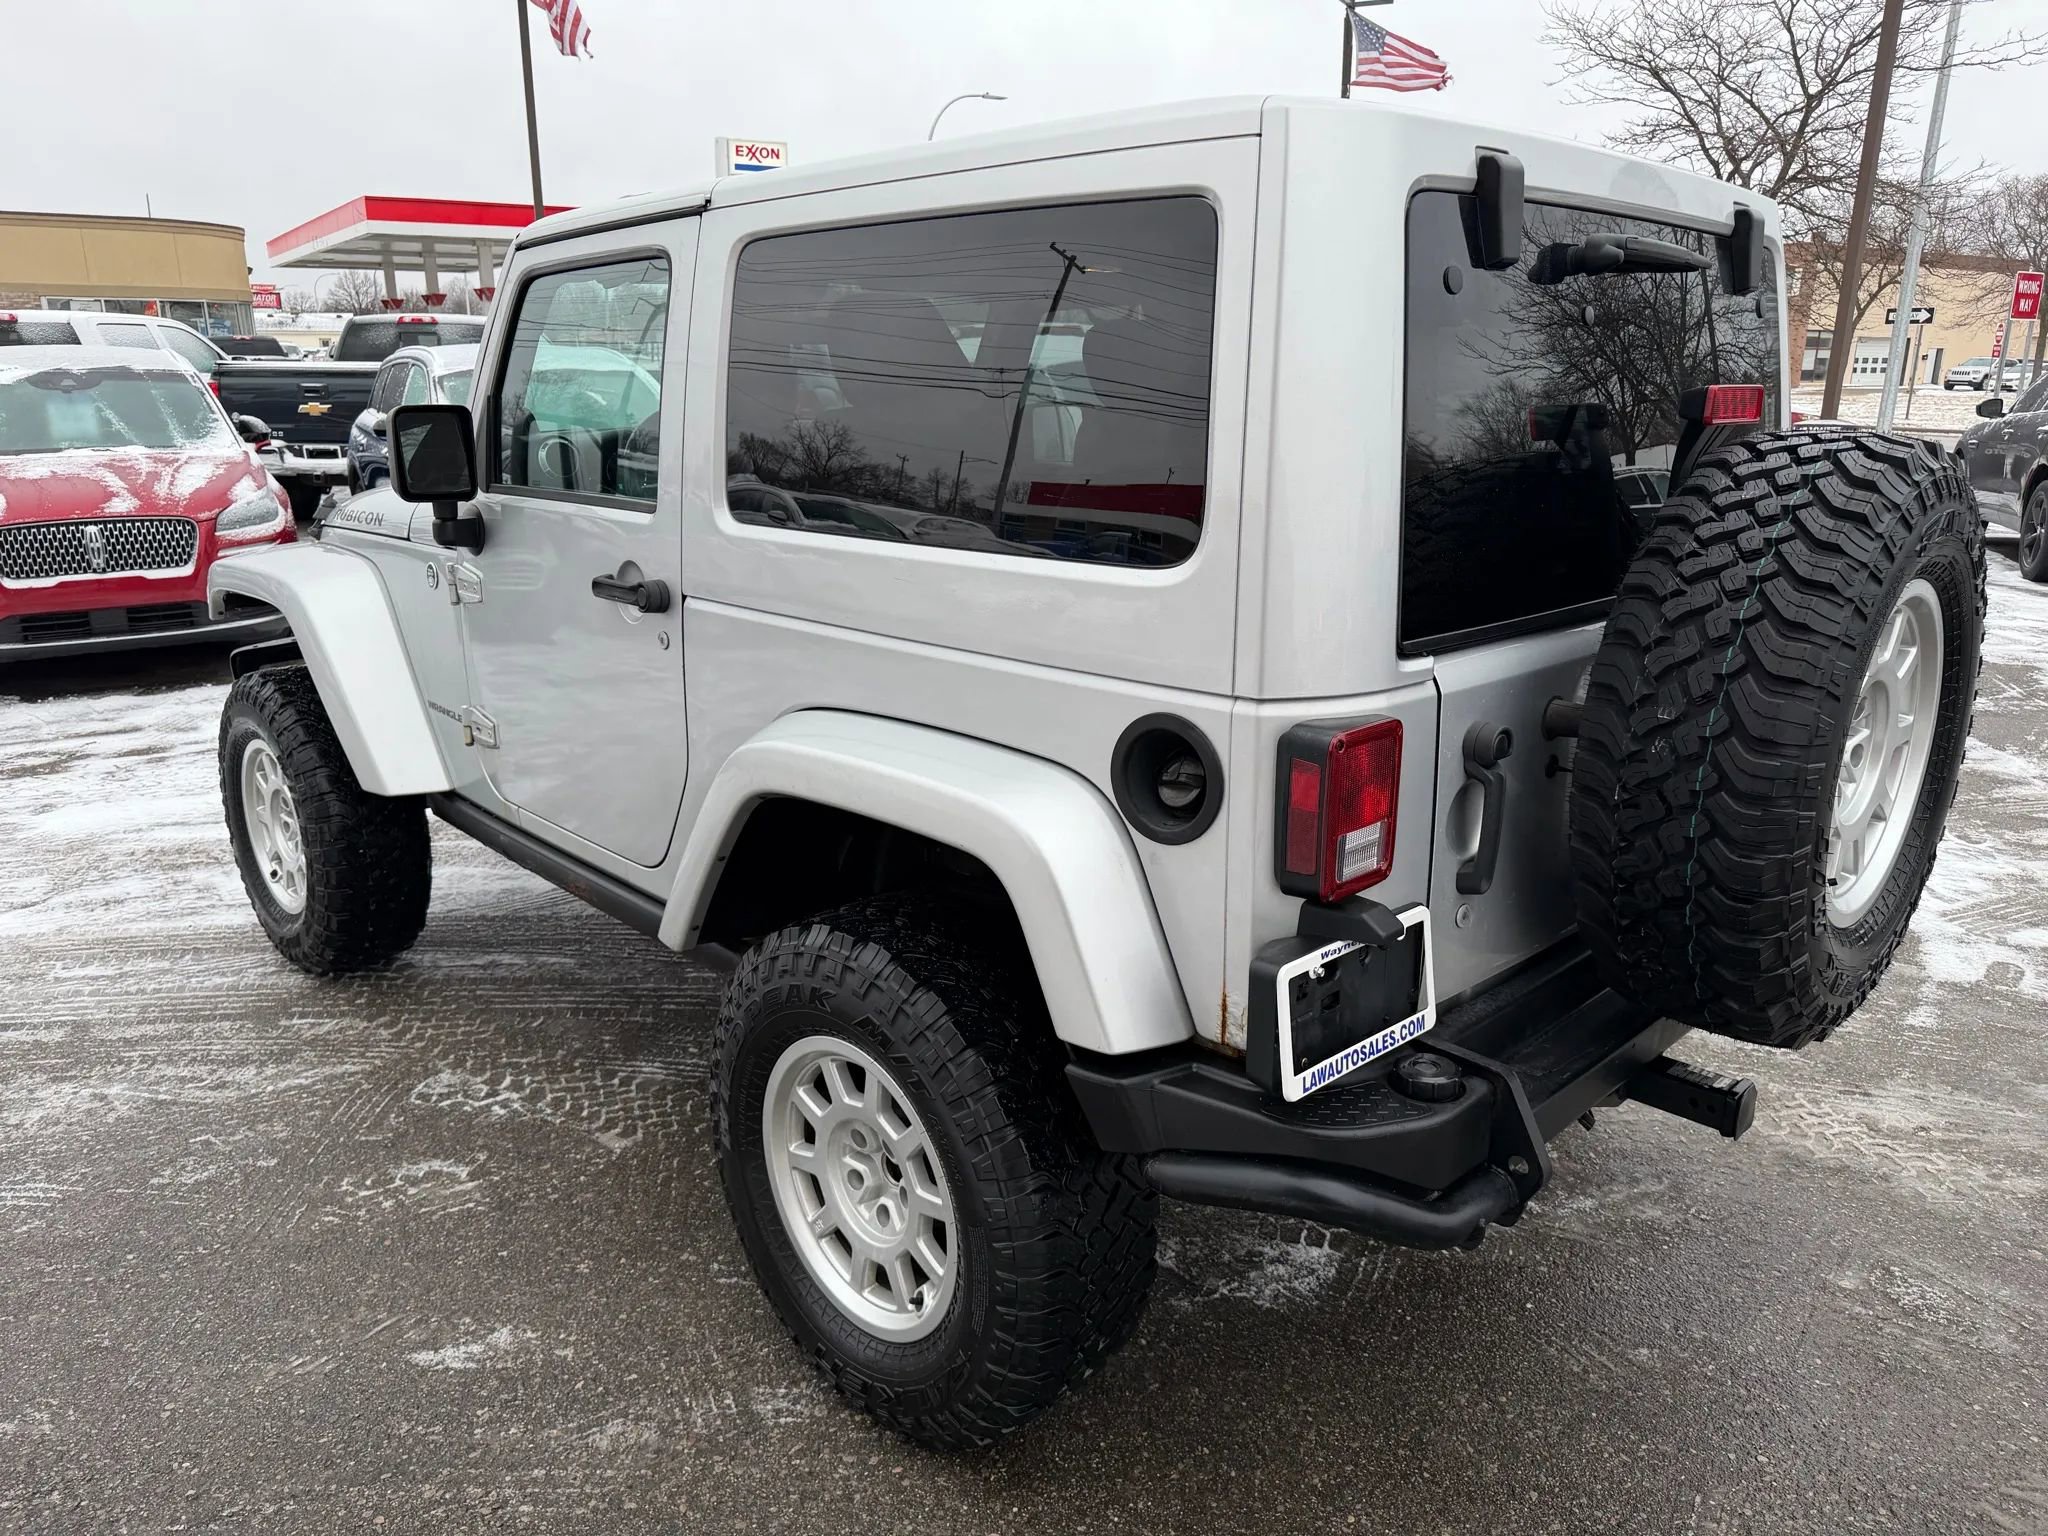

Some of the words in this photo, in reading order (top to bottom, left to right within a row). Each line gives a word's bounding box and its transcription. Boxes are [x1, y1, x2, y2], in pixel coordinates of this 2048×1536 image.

[735, 144, 781, 163] EXXON
[2018, 280, 2041, 295] WRONG
[2019, 299, 2034, 312] WAY
[333, 509, 385, 527] RUBICON
[1302, 1014, 1426, 1094] LAWAUTOSALES.COM
